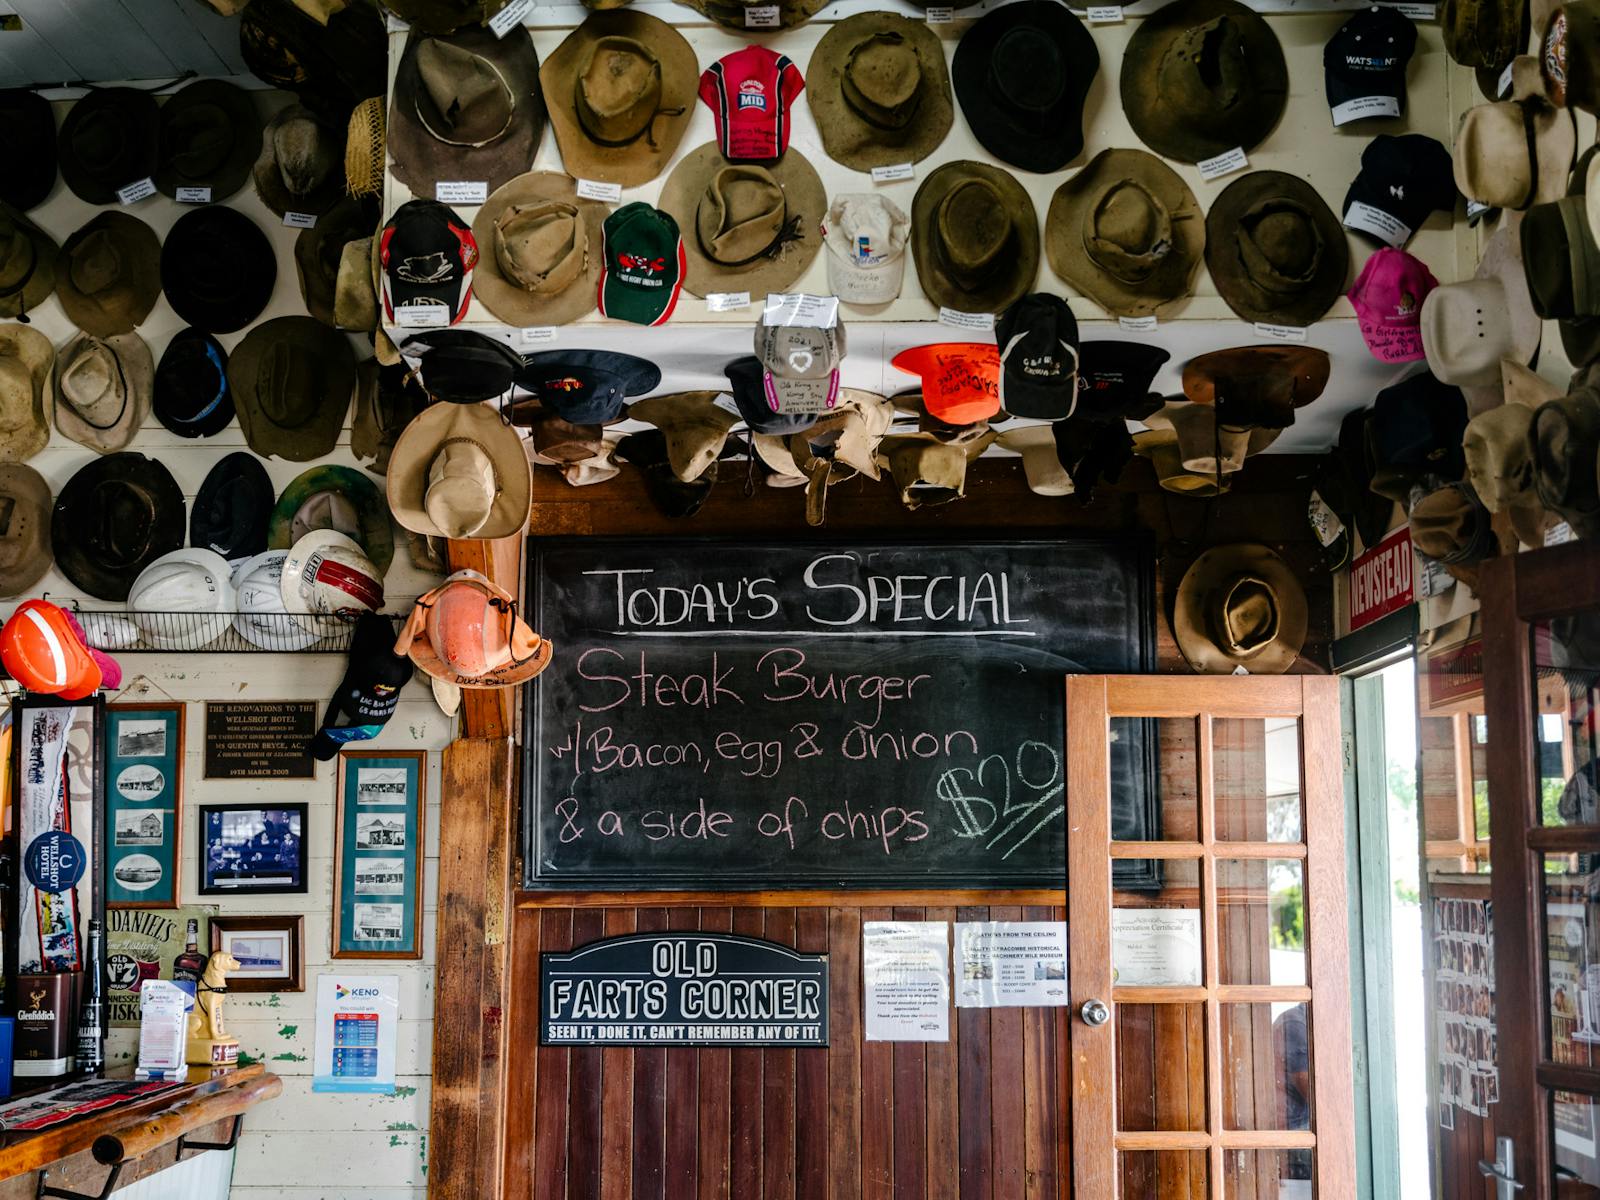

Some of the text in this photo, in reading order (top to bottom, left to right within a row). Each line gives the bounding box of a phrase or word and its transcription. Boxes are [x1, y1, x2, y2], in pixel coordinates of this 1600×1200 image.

[741, 95, 764, 106] MID
[582, 554, 1030, 626] TODAY'S SPECIAL
[1351, 540, 1411, 618] NEWSTEAD
[577, 647, 932, 730] Steak Burger
[209, 705, 224, 713] THE
[227, 705, 283, 713] RENOVATIONS
[715, 731, 782, 777] egg
[790, 722, 824, 759] &
[936, 740, 1059, 839] $20
[555, 796, 930, 855] & a side of chips
[41, 846, 49, 879] HOTEL
[51, 835, 59, 889] WELLSHOT
[112, 910, 177, 942] DANIEL'S
[111, 955, 128, 963] OLD
[652, 940, 718, 978] OLD
[351, 988, 379, 996] KENO
[550, 980, 820, 1019] FARTS CORNER
[18, 1010, 56, 1020] Glenfiddich
[549, 1026, 819, 1040] SEEN IT, DONE IT, CAN'T REMEMBER ANY OF IT!
